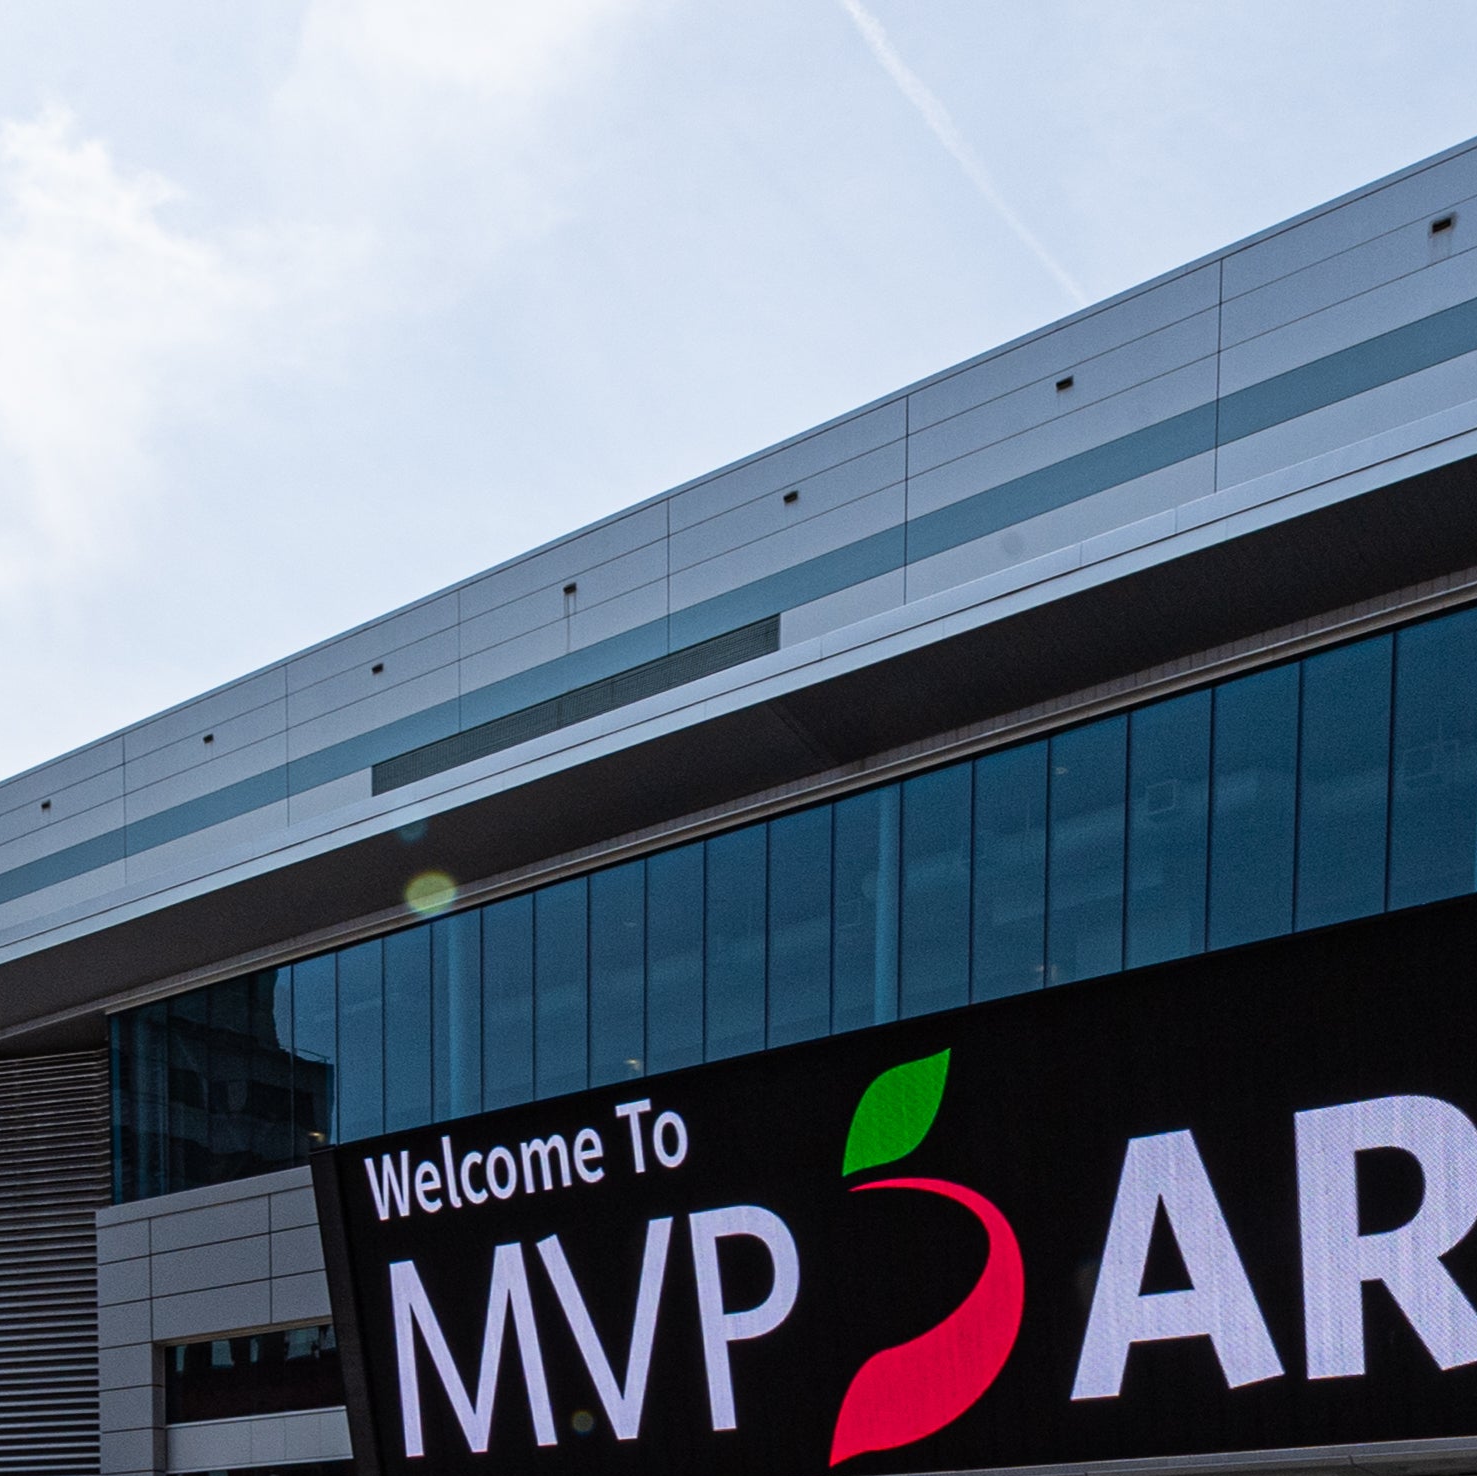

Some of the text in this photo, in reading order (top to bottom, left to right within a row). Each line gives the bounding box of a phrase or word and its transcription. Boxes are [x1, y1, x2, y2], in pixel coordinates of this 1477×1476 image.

[365, 1098, 689, 1222] Welcome To
[389, 1205, 801, 1458] MVP
